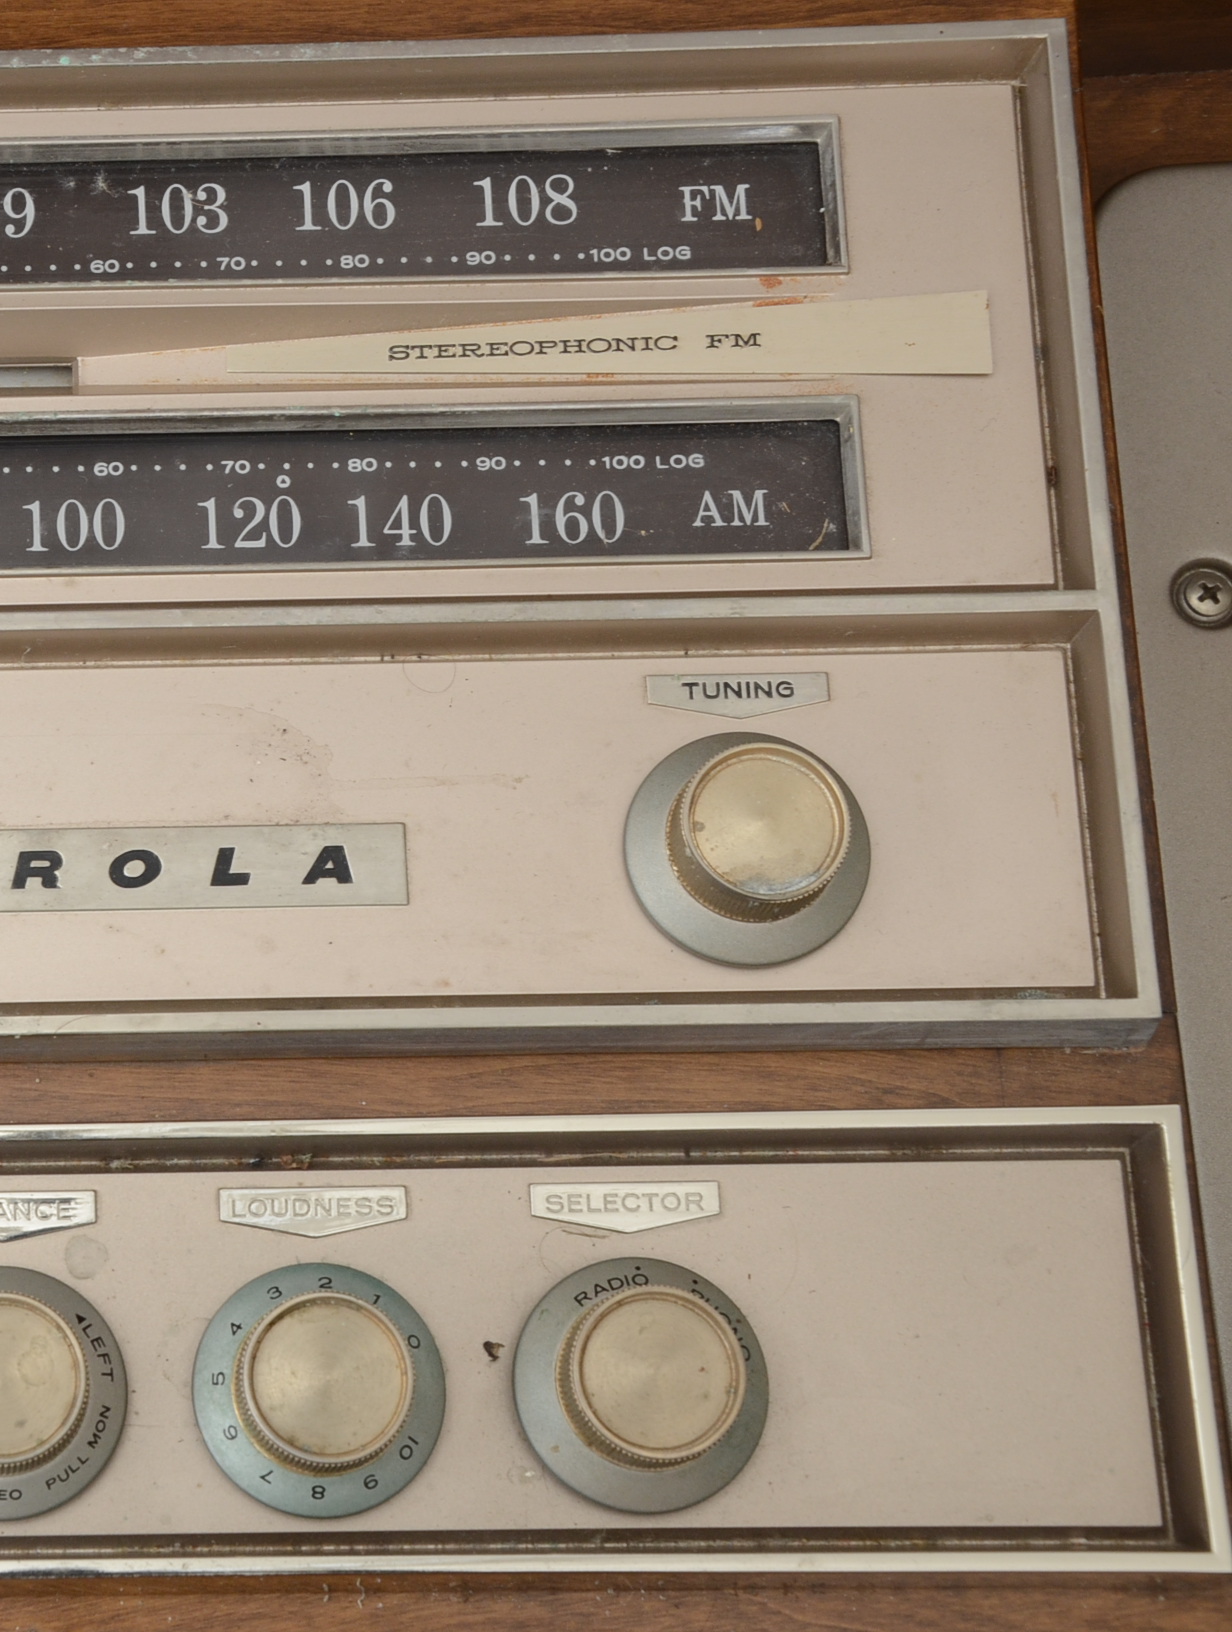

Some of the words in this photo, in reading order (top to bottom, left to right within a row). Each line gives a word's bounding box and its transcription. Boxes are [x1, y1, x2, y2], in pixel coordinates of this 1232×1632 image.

[127, 183, 228, 234] 103
[293, 179, 396, 230] 106
[473, 174, 577, 226] 108
[679, 184, 752, 221] FM
[90, 259, 120, 273] 60
[216, 257, 246, 270] 70
[340, 254, 370, 269] 80
[466, 251, 496, 265] 90
[589, 247, 631, 262] 100
[643, 246, 691, 260] LOG
[388, 336, 678, 362] STEREOPHONIC
[705, 333, 761, 349] FM
[94, 462, 124, 476] 60
[221, 460, 251, 474] 70
[348, 458, 378, 472] 80
[476, 457, 506, 471] 90
[602, 455, 645, 469] 100
[656, 453, 705, 469] LOG
[22, 498, 125, 551] 100
[197, 495, 301, 549] 120
[347, 494, 452, 548] 140
[519, 490, 625, 545] 160
[692, 490, 770, 527] AM
[682, 680, 794, 699] TUNING
[232, 1197, 395, 1219] LOUDNESS
[545, 1192, 704, 1213] SELECTOR
[318, 1276, 333, 1289] 2
[574, 1273, 649, 1307] RADIO
[267, 1286, 283, 1300] 3
[372, 1294, 381, 1305] 1
[230, 1322, 243, 1336] 4
[407, 1334, 421, 1349] 0
[83, 1324, 114, 1382] LEFT
[212, 1371, 225, 1385] 5
[223, 1425, 238, 1440] 6
[45, 1457, 89, 1490] PULL
[88, 1404, 111, 1450] MON
[399, 1435, 419, 1460] 10
[259, 1470, 274, 1484] 7
[363, 1474, 379, 1489] 9
[311, 1485, 326, 1499] 8
